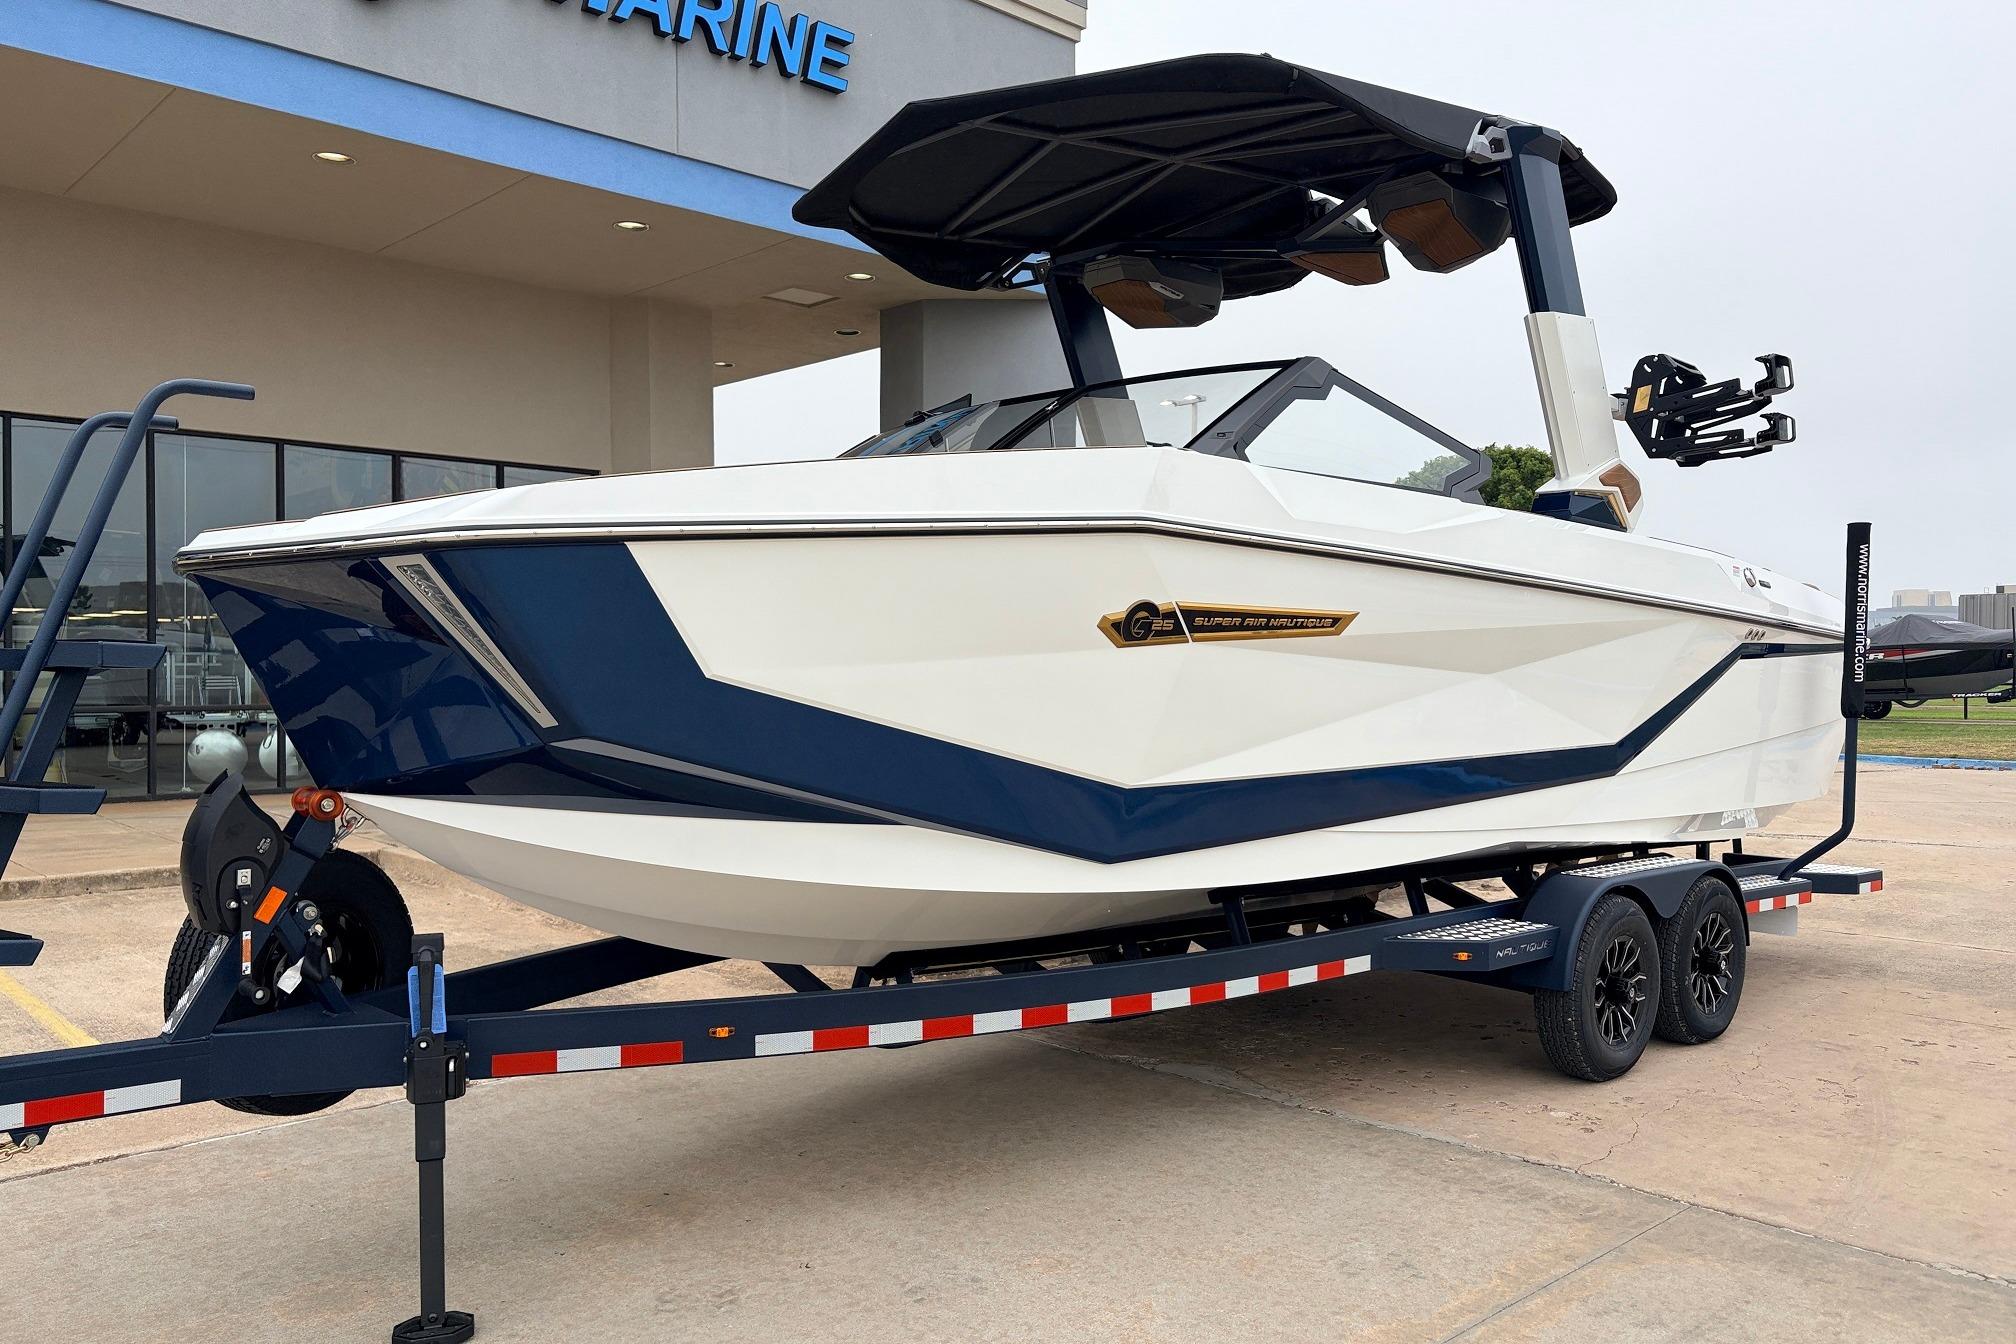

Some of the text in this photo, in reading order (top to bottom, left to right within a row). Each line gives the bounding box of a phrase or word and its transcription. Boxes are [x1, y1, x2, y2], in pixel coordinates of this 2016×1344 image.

[552, 0, 855, 95] ARINE
[1192, 617, 1241, 627] SUPER
[1244, 617, 1268, 627] AIR
[1268, 618, 1334, 628] NAUTIQUE
[1854, 544, 1869, 682] www.norrismarine.com
